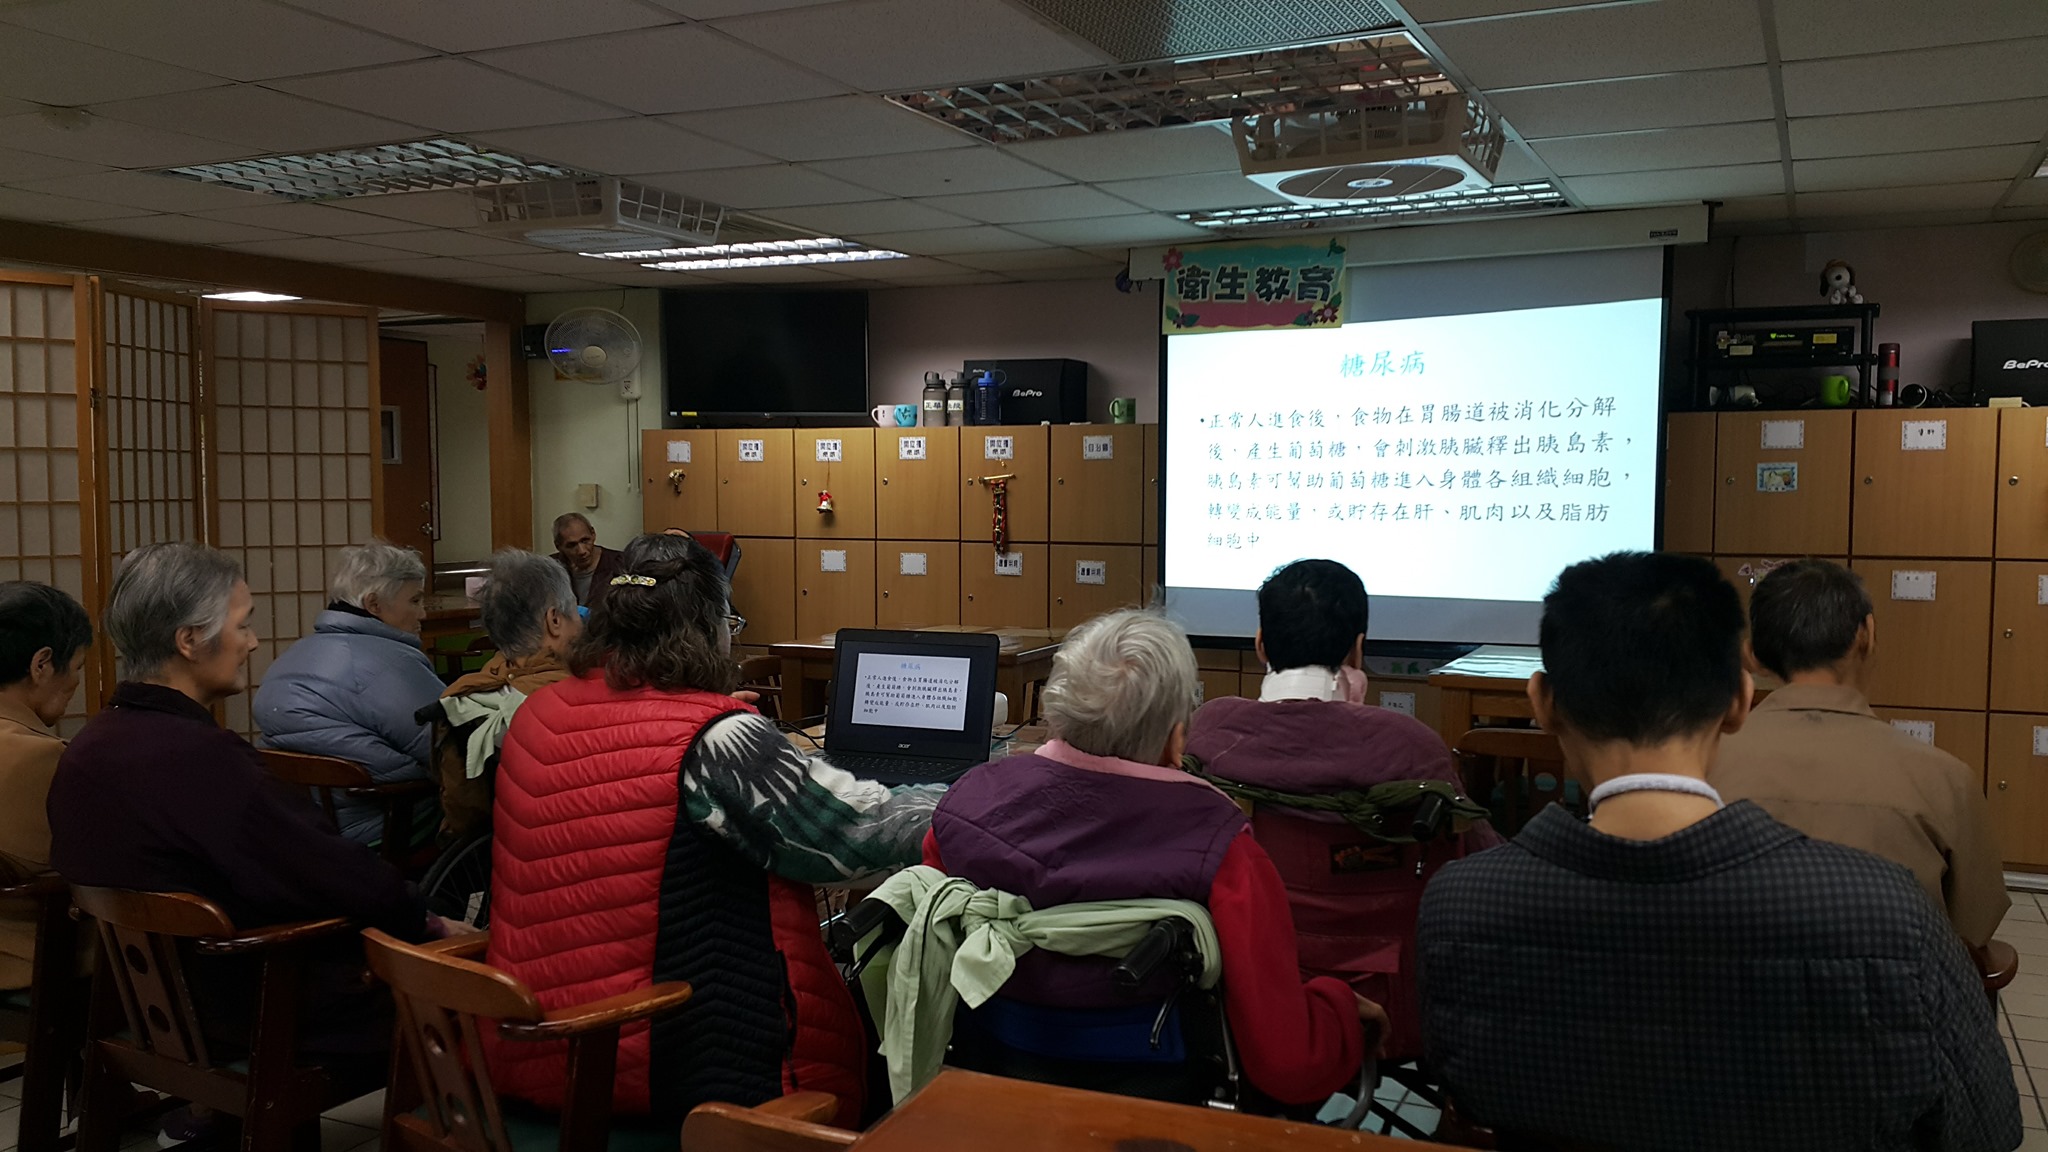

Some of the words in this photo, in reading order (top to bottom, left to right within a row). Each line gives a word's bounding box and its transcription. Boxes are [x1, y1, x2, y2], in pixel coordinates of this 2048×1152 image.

[1176, 264, 1337, 303] 衛生教育
[1340, 349, 1427, 378] 糖尿病
[1012, 389, 1043, 397] BePro
[1207, 532, 1260, 549] 細胞中
